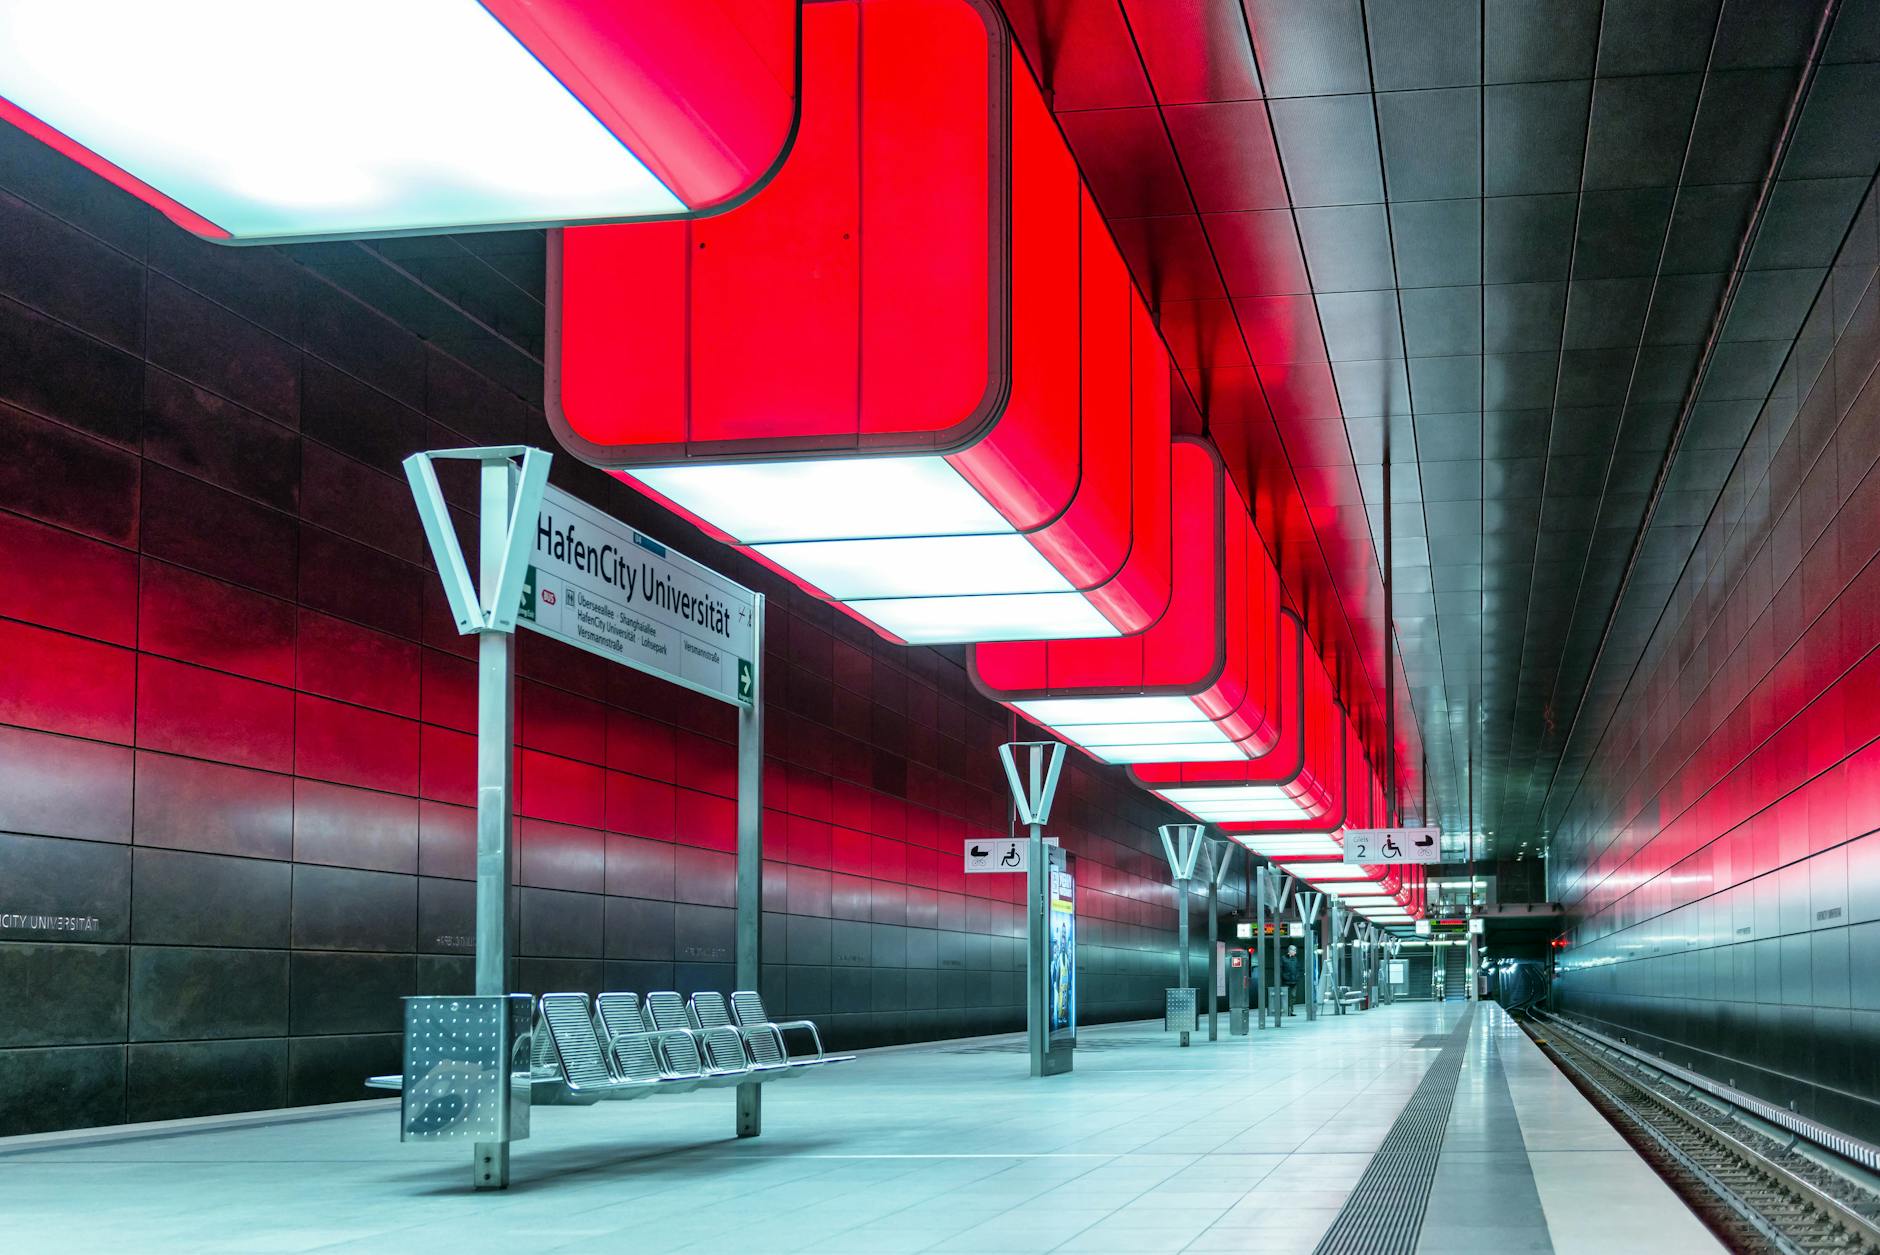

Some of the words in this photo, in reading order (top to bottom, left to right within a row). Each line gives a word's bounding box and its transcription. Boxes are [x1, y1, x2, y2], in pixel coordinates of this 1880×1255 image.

[537, 511, 637, 603] HafenCity
[642, 563, 730, 638] Universität
[577, 609, 606, 632] HafenCity
[606, 620, 636, 644] Universität
[577, 625, 624, 654] Versmannstraße
[1357, 845, 1366, 858] 2
[30, 914, 99, 931] UNIVERSITÄT
